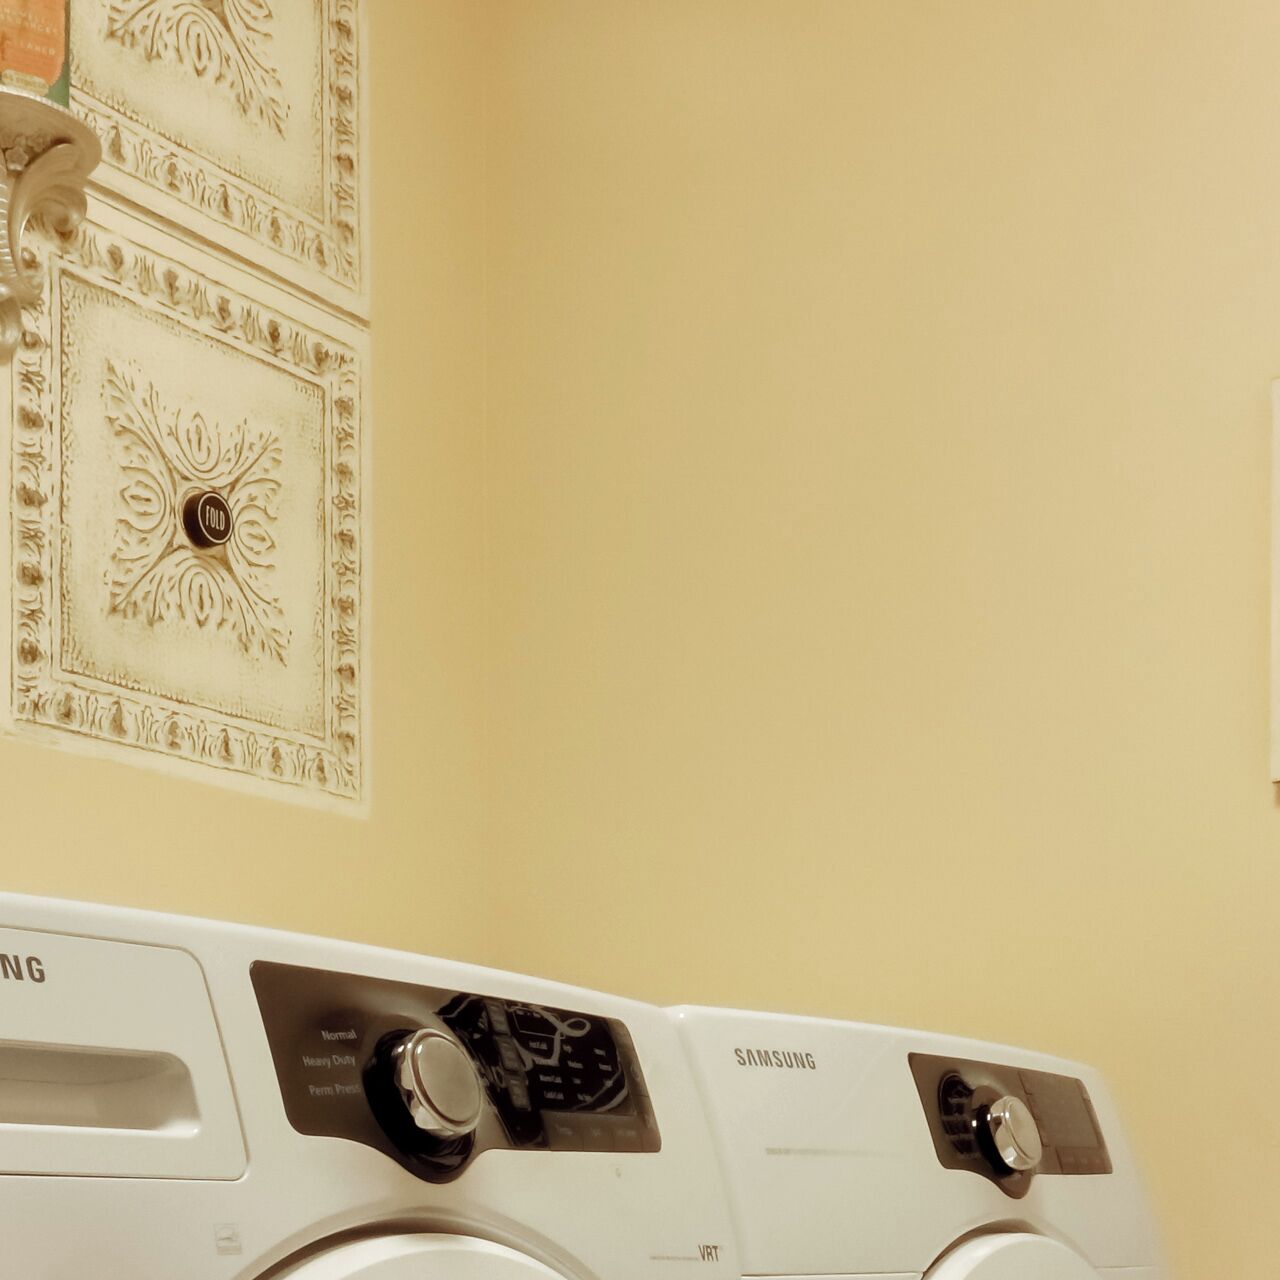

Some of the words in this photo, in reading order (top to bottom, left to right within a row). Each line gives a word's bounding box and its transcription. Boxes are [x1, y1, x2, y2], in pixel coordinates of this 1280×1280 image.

[205, 505, 226, 531] FOLD
[320, 1028, 358, 1041] Normal
[302, 1055, 331, 1069] Heavy
[332, 1054, 356, 1067] Duty
[733, 1047, 817, 1071] SAMSUNG
[308, 1084, 333, 1097] Perm
[334, 1083, 362, 1095] Press
[697, 1244, 719, 1262] VRT
